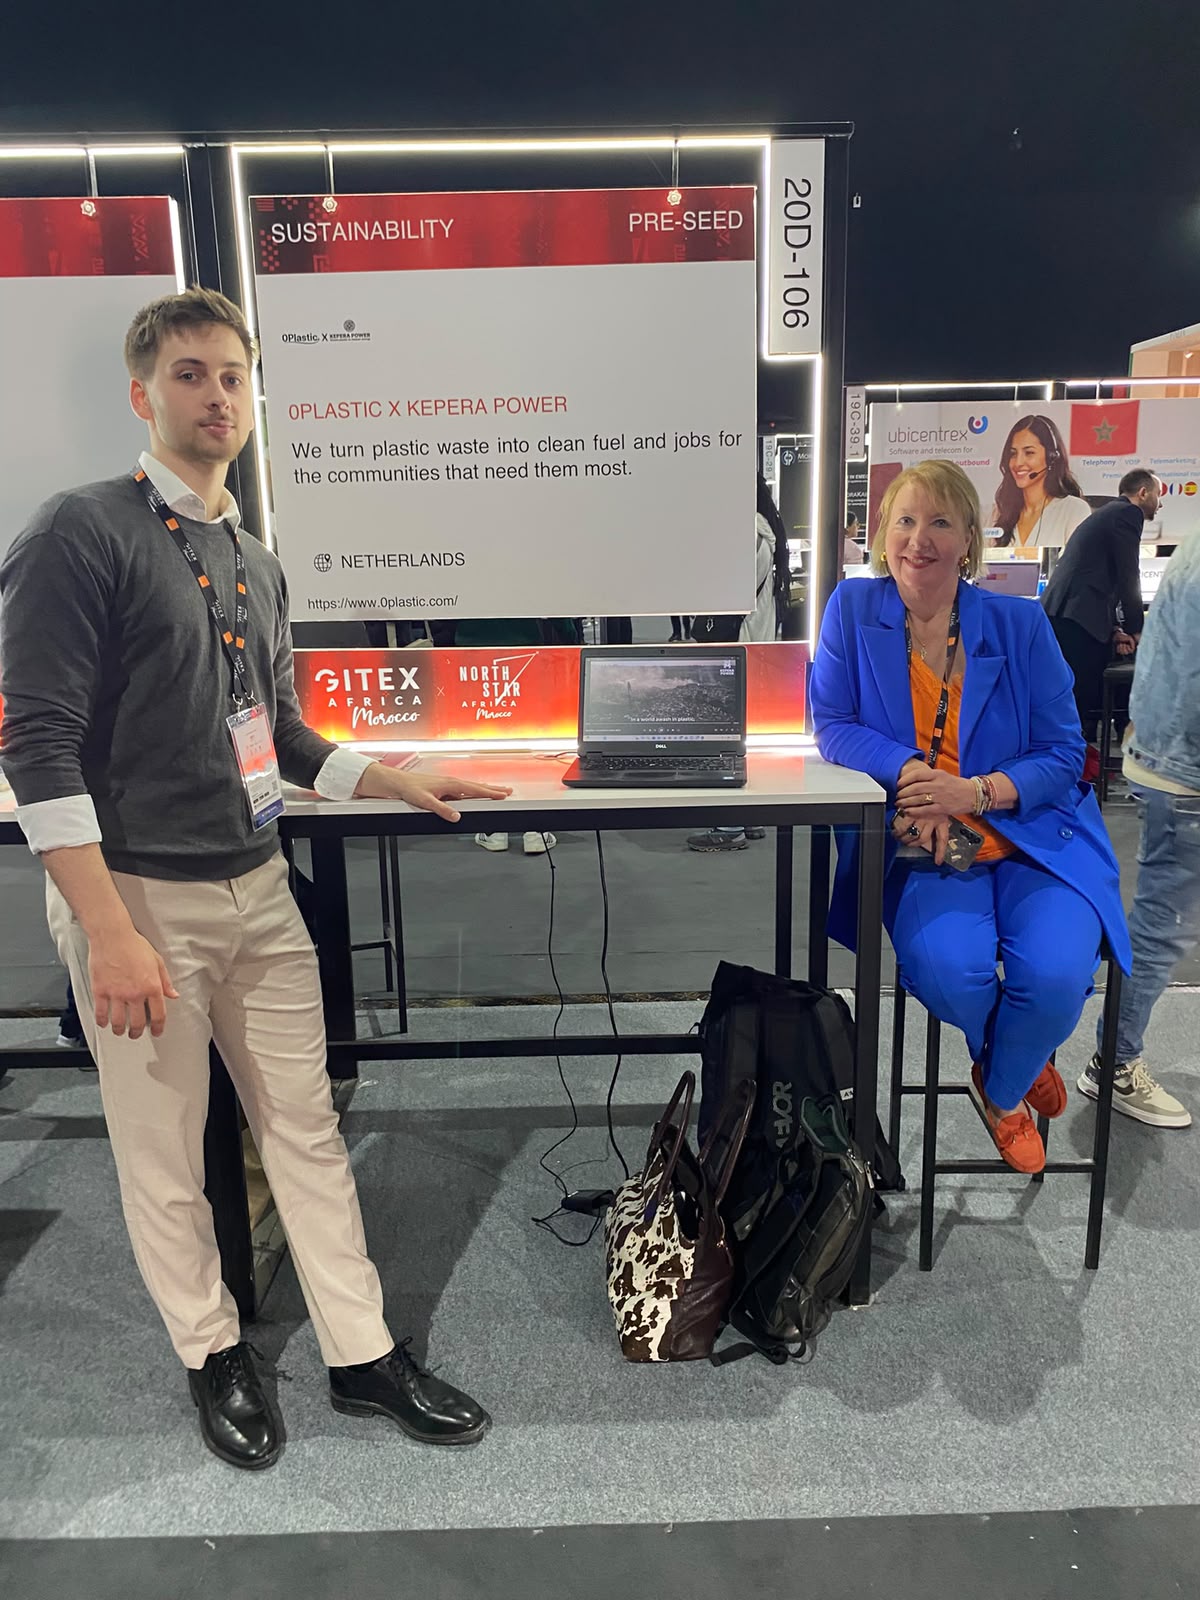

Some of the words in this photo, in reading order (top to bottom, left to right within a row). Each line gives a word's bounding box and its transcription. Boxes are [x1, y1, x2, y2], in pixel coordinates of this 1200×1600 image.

[628, 210, 744, 233] PRE-SEED
[271, 218, 455, 244] SUSTAINABILITY
[782, 177, 812, 329] 20D-106
[321, 332, 329, 342] X
[388, 400, 401, 417] X
[407, 398, 488, 417] KEPERA
[493, 396, 568, 415] POWER
[849, 393, 861, 456] 19C-39.1
[888, 426, 969, 444] ubicentrex
[291, 442, 322, 459] We
[329, 442, 365, 459] turn
[372, 439, 430, 461] plastic
[437, 438, 490, 456] waste
[497, 436, 530, 454] into
[537, 435, 585, 453] clean
[593, 433, 626, 451] fuel
[633, 432, 666, 450] and
[673, 431, 712, 453] jobs
[718, 430, 743, 447] for
[889, 447, 919, 456] Software
[920, 447, 934, 455] and
[935, 446, 962, 454] telecom
[1082, 459, 1117, 467] Telephony
[294, 467, 322, 485] the
[327, 464, 440, 484] communities
[445, 463, 479, 480] that
[485, 461, 529, 479] need
[534, 461, 578, 478] them
[584, 460, 632, 477] most.
[340, 552, 466, 569] NETHERLANDS
[314, 666, 420, 693] GITEX
[459, 665, 510, 682] NORTH
[482, 681, 521, 698] STAR
[328, 695, 423, 708] AFRICA
[461, 700, 517, 708] AFRICA
[352, 706, 420, 729] Morocco
[476, 708, 513, 721] Morocco
